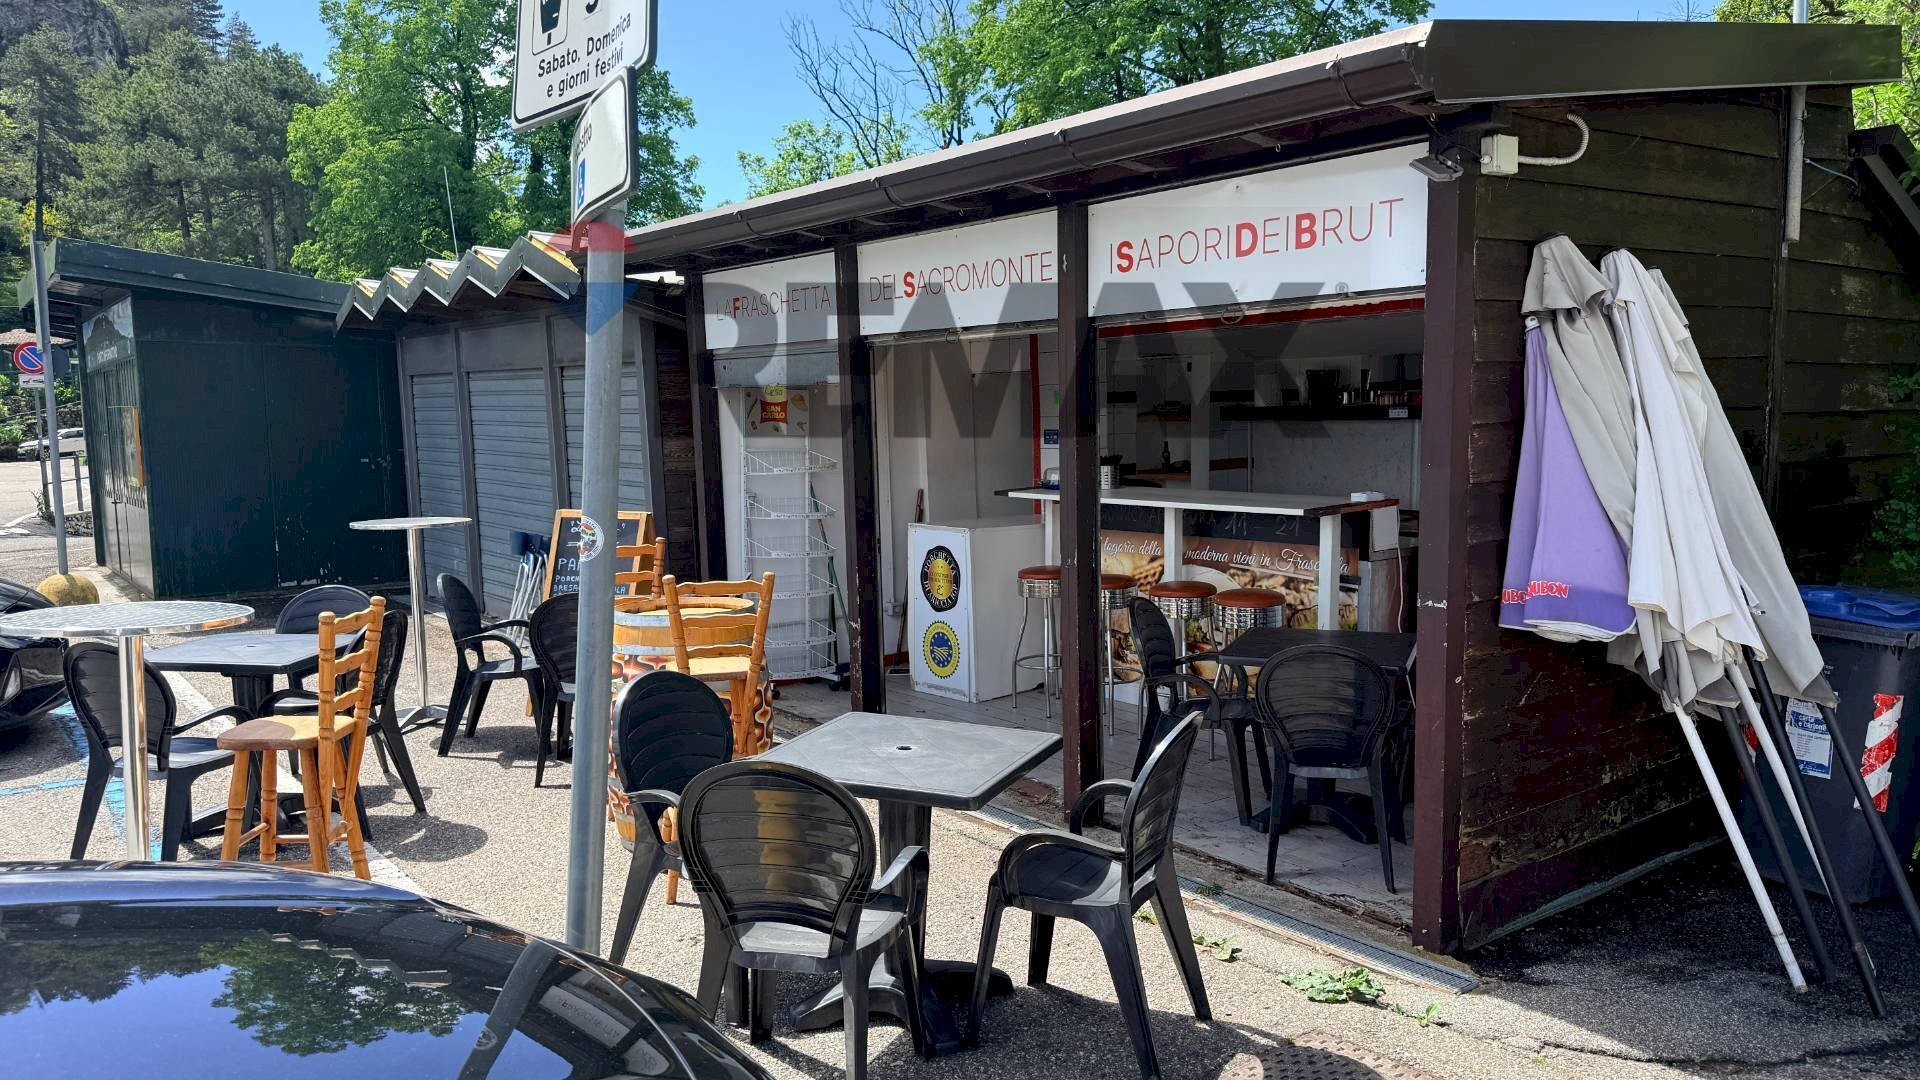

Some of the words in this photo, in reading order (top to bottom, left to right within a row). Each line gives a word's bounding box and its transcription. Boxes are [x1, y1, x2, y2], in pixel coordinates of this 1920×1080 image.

[586, 12, 631, 57] Domenica
[547, 83, 554, 97] e
[558, 64, 590, 97] giorni
[595, 41, 624, 78] festivi
[1184, 545, 1229, 562] moderna
[1233, 551, 1257, 565] vieni
[1259, 554, 1272, 567] in
